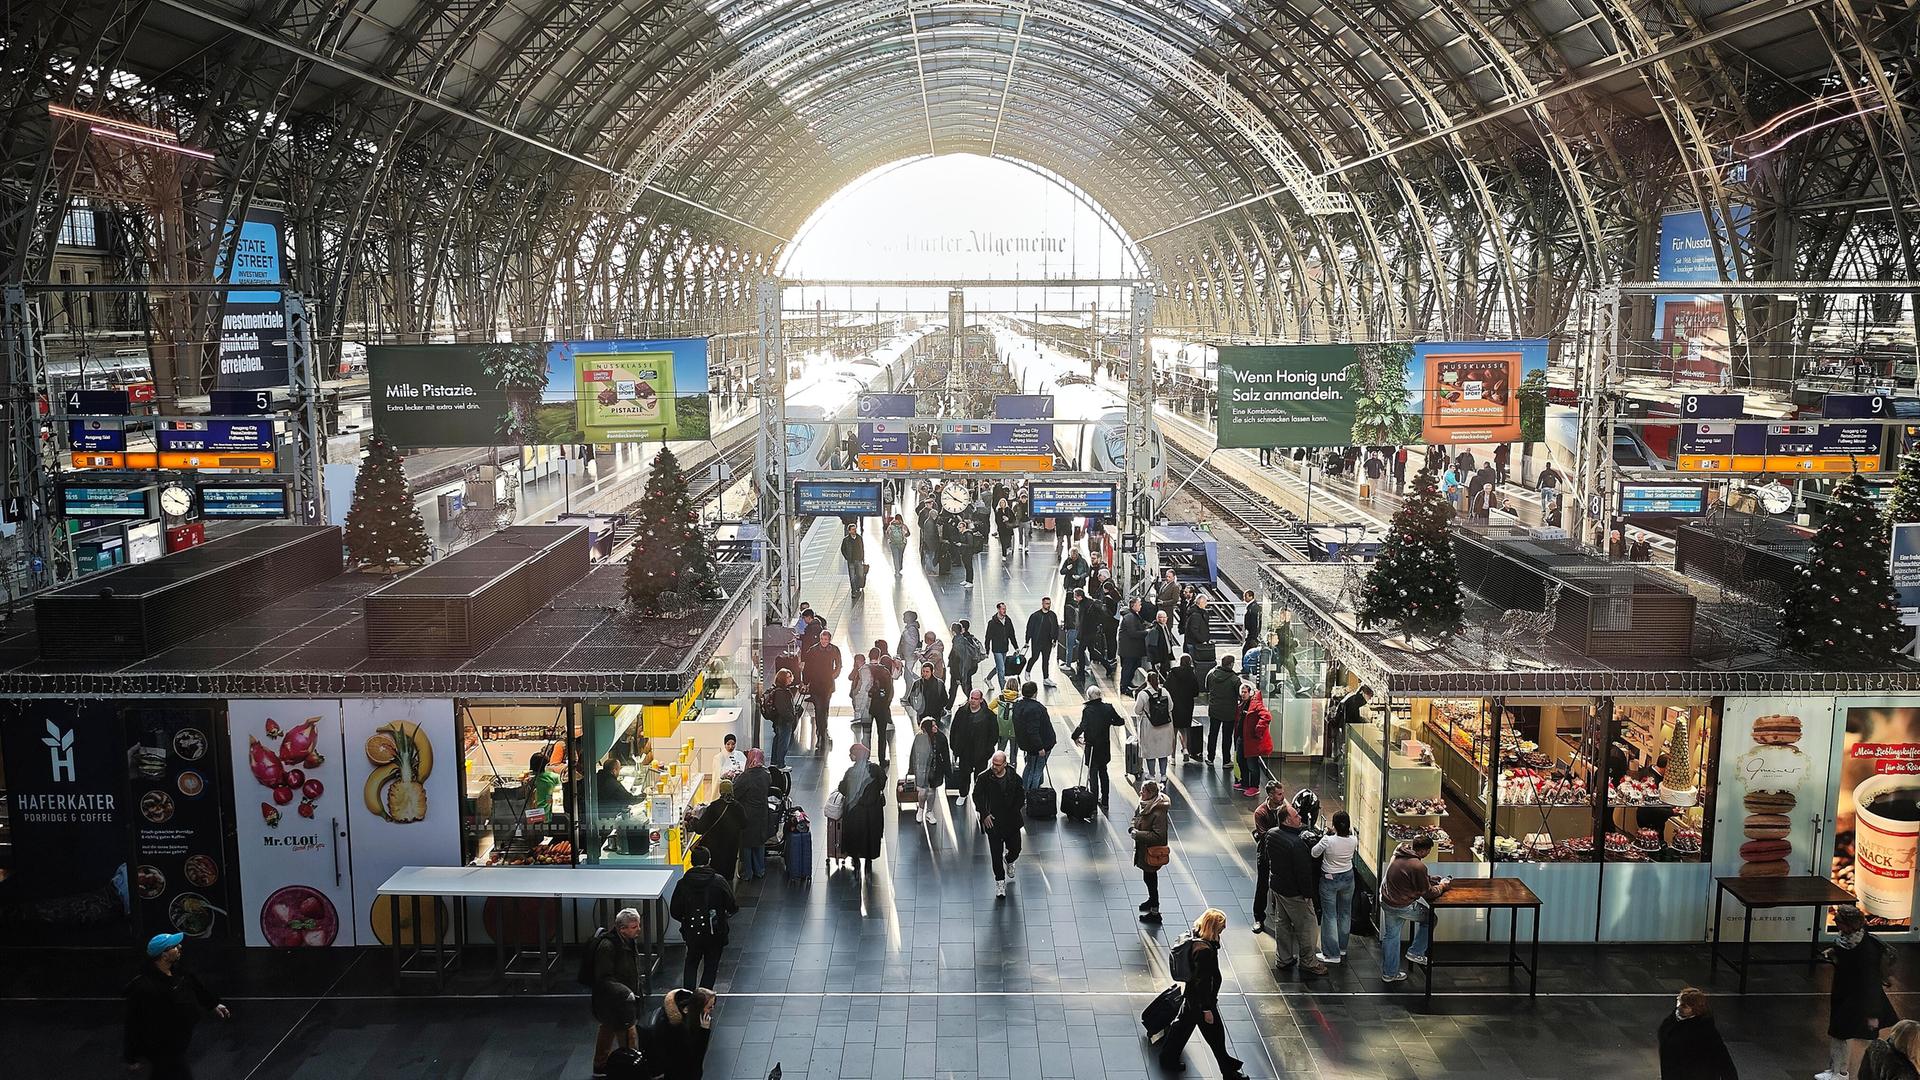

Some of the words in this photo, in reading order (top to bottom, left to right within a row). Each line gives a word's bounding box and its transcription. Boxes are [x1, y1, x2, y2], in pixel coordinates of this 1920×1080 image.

[236, 238, 266, 253] STATE
[966, 230, 1066, 256] Allgemeine
[1672, 236, 1684, 251] Für
[237, 254, 274, 268] STREET
[238, 270, 268, 279] INVESTMENT
[220, 354, 264, 374] erreichen.
[1233, 370, 1272, 384] Wenn
[1276, 369, 1317, 386] Honig
[1321, 370, 1346, 382] und
[386, 384, 419, 398] Mille
[422, 384, 477, 397] Pistazie.
[1232, 388, 1260, 402] Salz
[1264, 386, 1343, 401] anmandeln.
[70, 392, 80, 409] 4
[256, 392, 268, 409] 5
[387, 404, 404, 412] Extra
[466, 402, 480, 410] drin.
[860, 396, 871, 412] 6
[1040, 396, 1051, 412] 7
[1686, 396, 1698, 412] 8
[1872, 397, 1882, 413] 9
[1232, 416, 1243, 424] die
[1774, 426, 1781, 434] U
[1807, 426, 1814, 434] S
[10, 498, 19, 517] 4
[308, 500, 316, 519] 5
[1592, 496, 1599, 514] 8
[1854, 746, 1874, 756] Mein
[18, 794, 116, 811] HAFERKATER
[24, 813, 68, 822] PORRIDGE
[80, 813, 112, 822] COFFEE
[264, 836, 282, 846] Mr.
[284, 834, 318, 846] CLOU
[1858, 842, 1892, 868] SNACK
